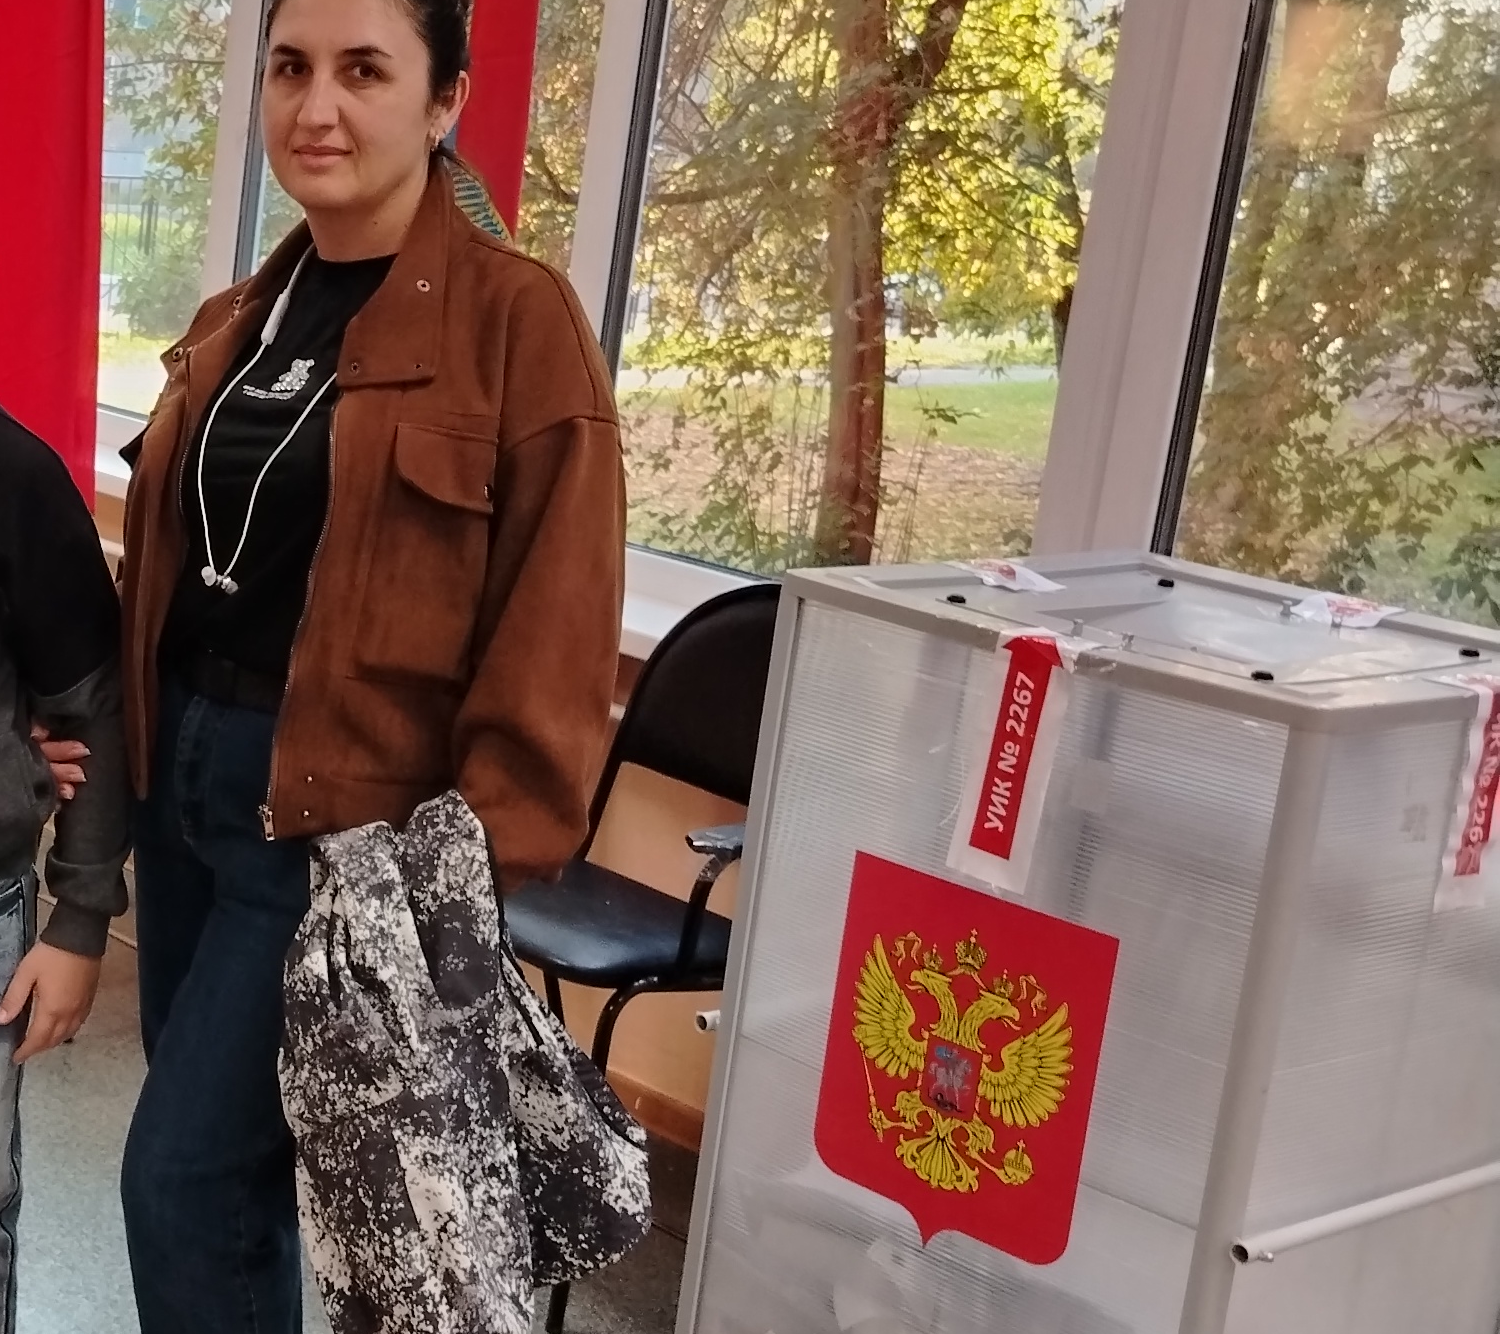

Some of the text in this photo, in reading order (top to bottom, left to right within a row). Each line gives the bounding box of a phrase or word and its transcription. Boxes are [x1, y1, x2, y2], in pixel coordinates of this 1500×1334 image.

[984, 671, 1035, 832] УИК № 2267
